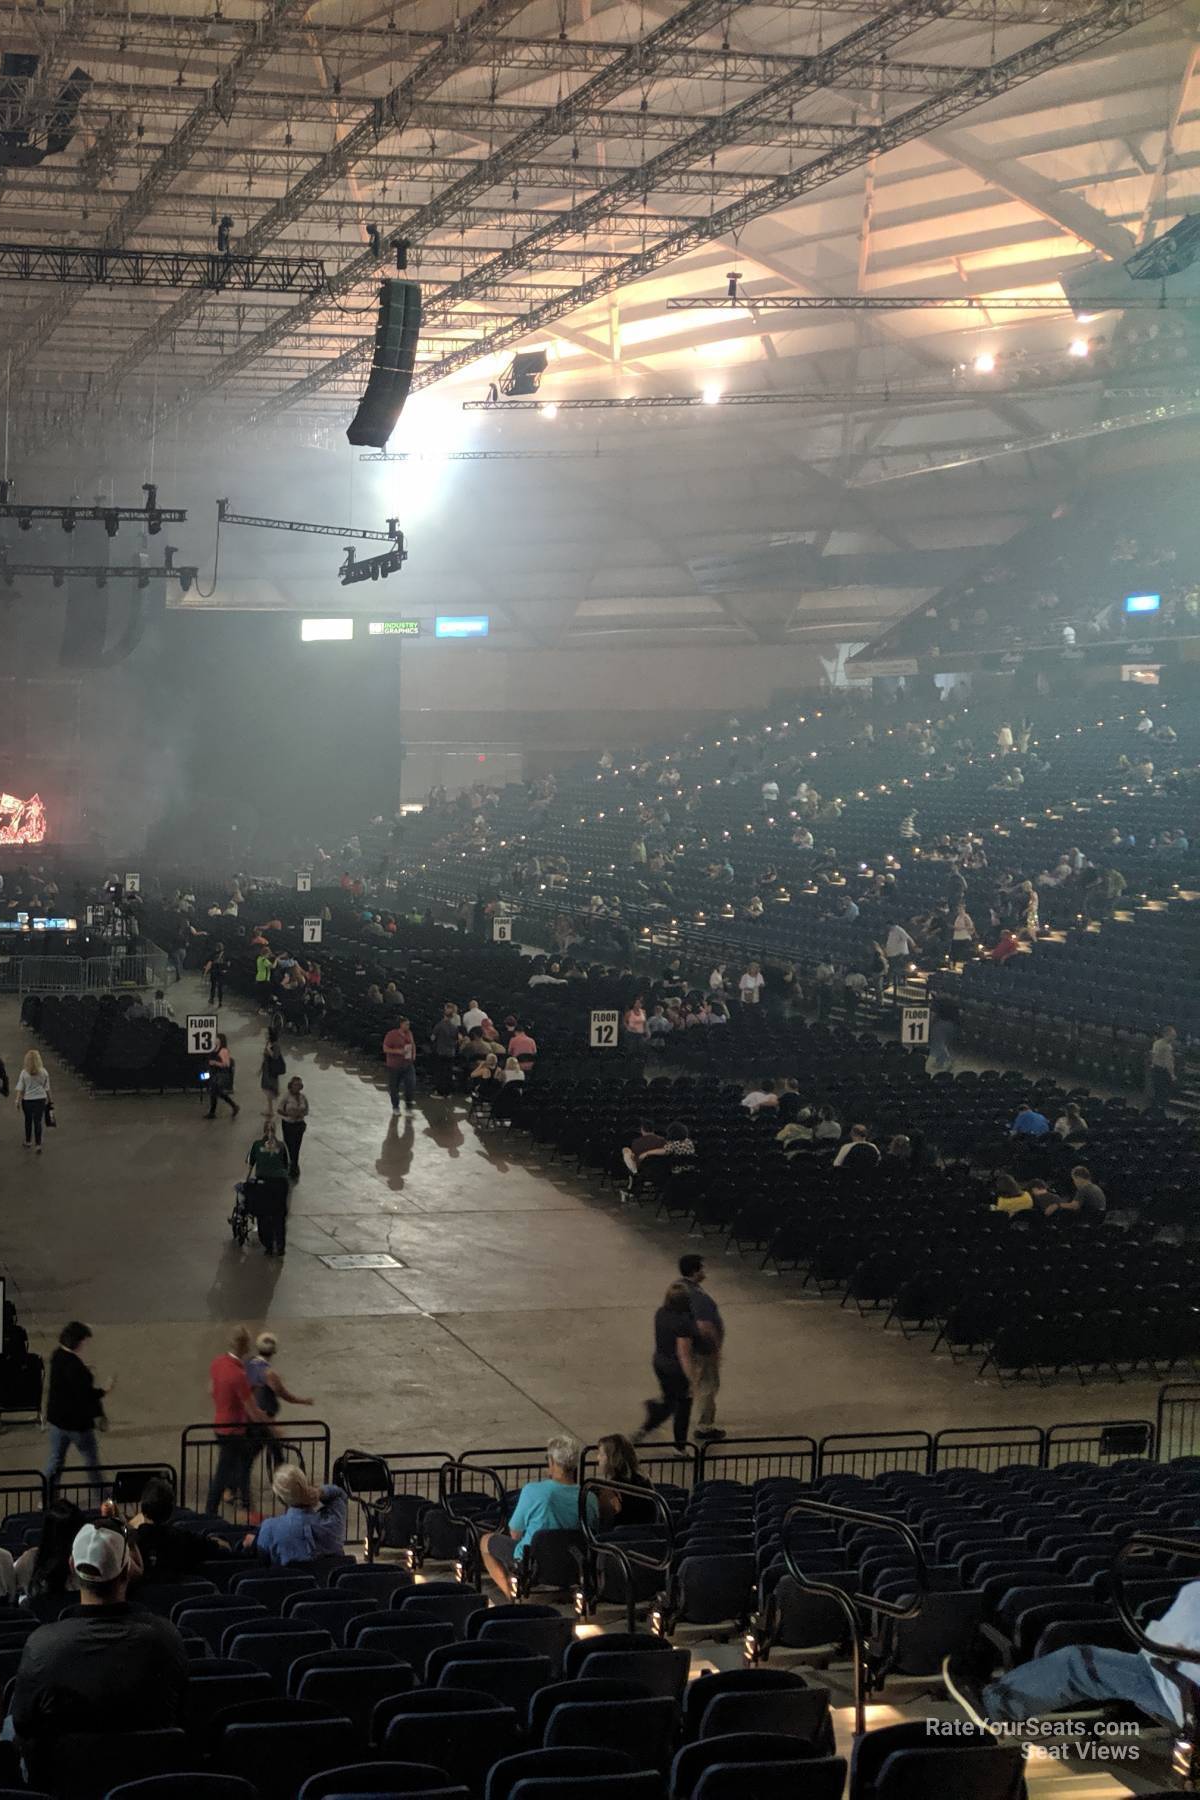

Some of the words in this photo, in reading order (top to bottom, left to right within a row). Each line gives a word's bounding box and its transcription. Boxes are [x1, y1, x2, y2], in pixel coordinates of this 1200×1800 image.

[130, 880, 136, 890] 2
[309, 928, 316, 940] 7
[499, 927, 506, 939] 6
[593, 1013, 617, 1022] FLOOR
[904, 1010, 928, 1019] FLOOR
[190, 1019, 215, 1028] FLOOR
[595, 1025, 614, 1044] 12
[908, 1022, 924, 1040] 11
[192, 1031, 212, 1050] 13
